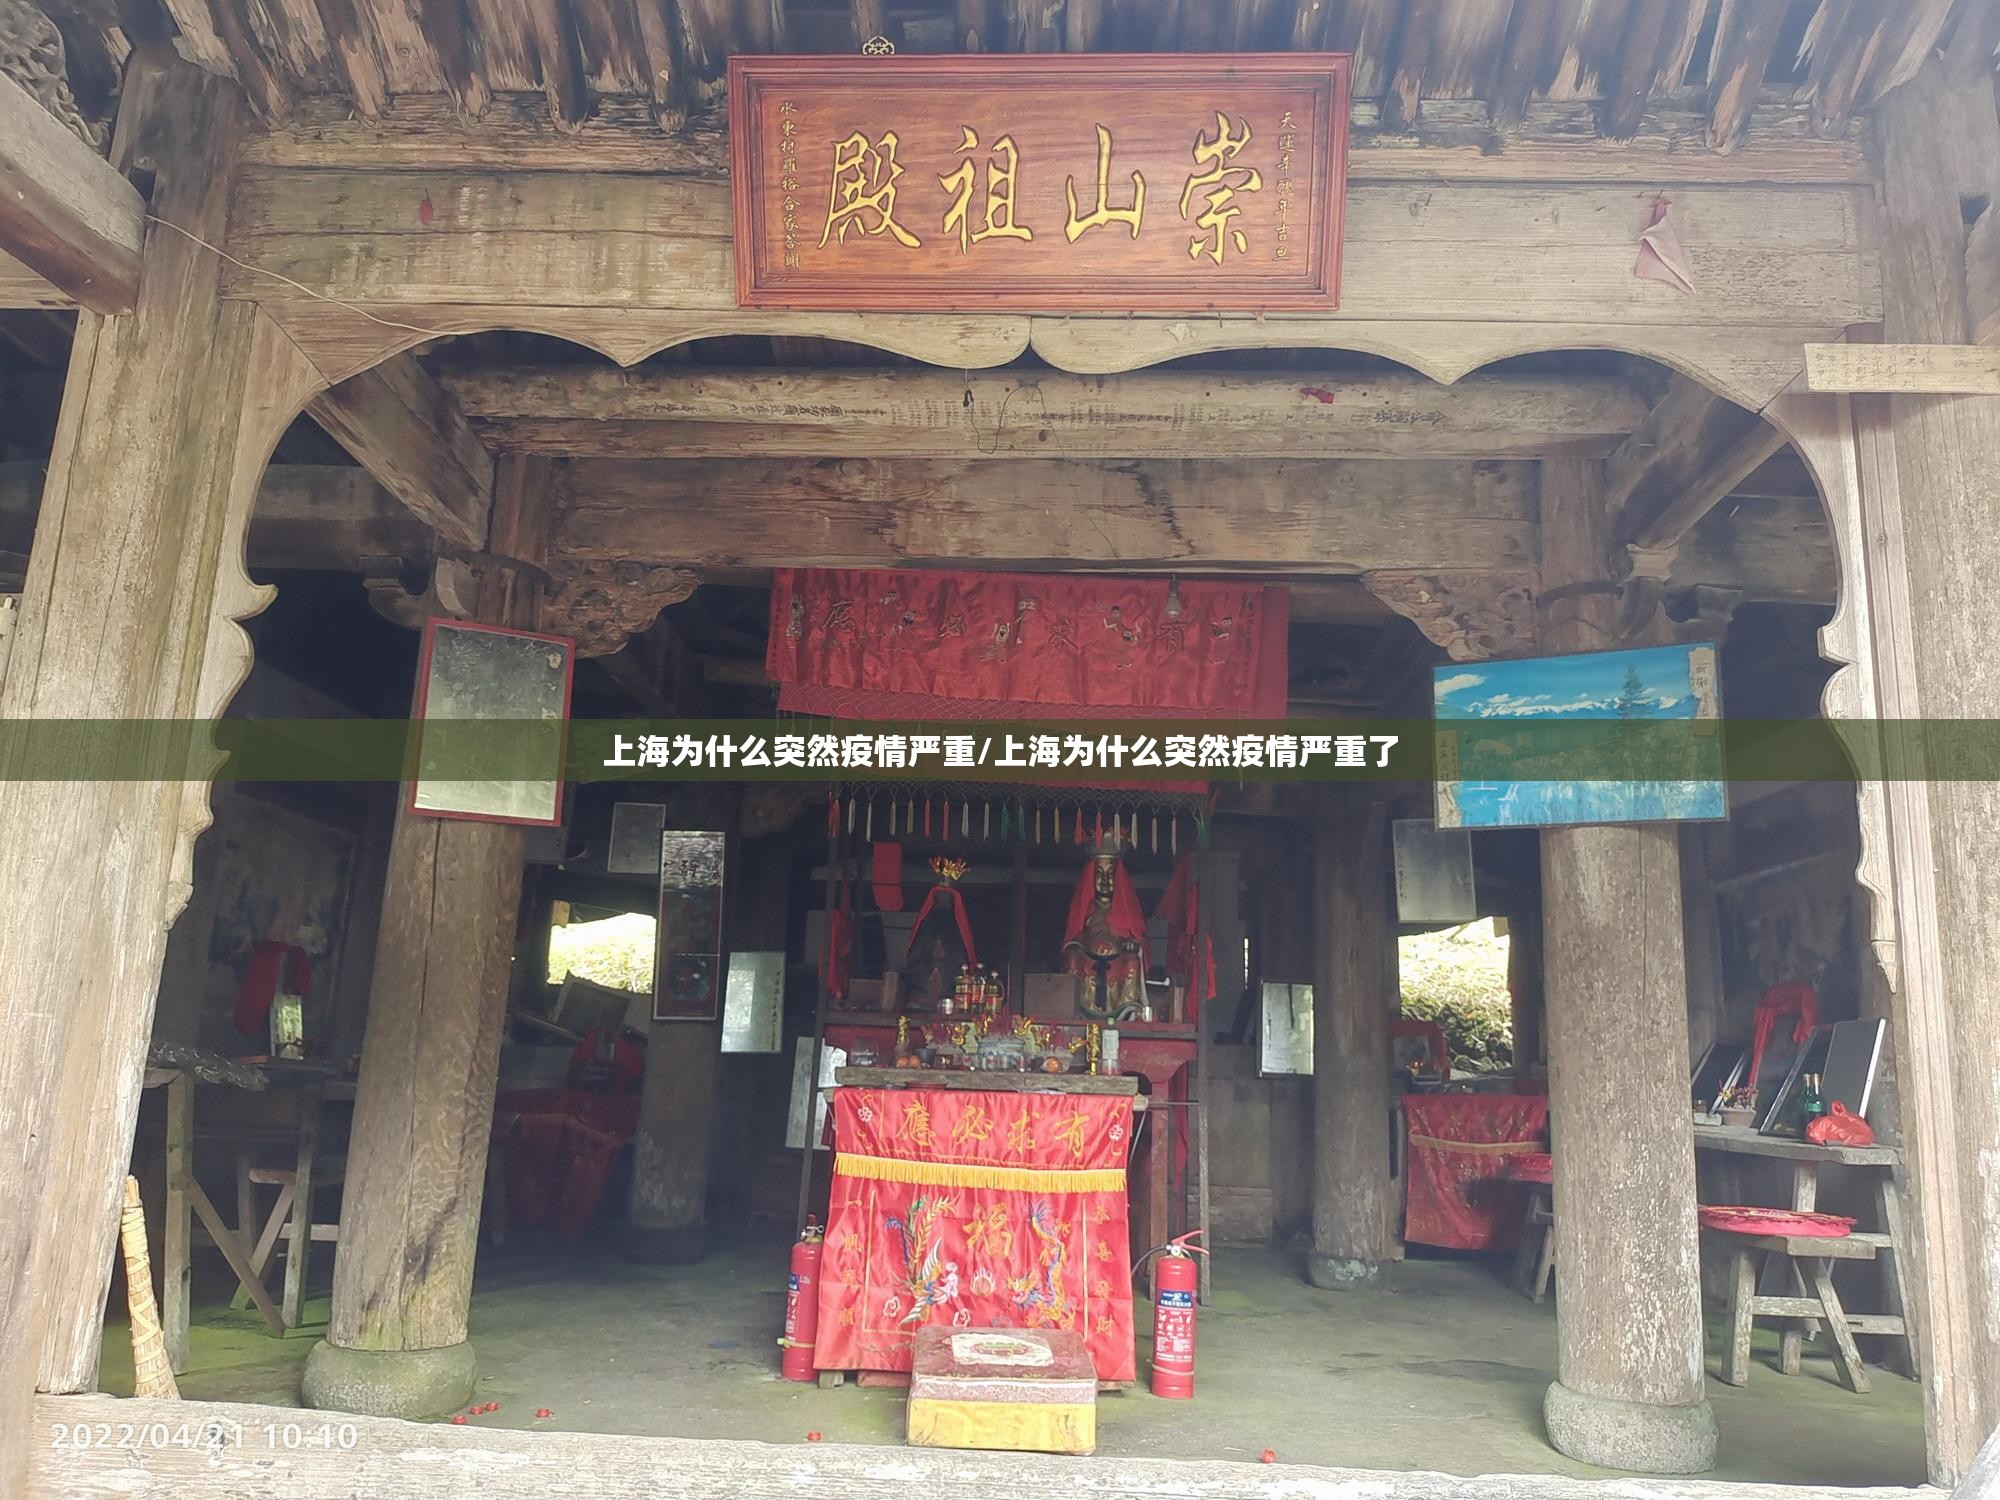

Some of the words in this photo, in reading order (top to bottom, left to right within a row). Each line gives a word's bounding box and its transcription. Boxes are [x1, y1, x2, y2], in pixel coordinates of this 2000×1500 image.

[817, 110, 1264, 266] 崇山祖殿
[962, 1202, 1013, 1258] 福
